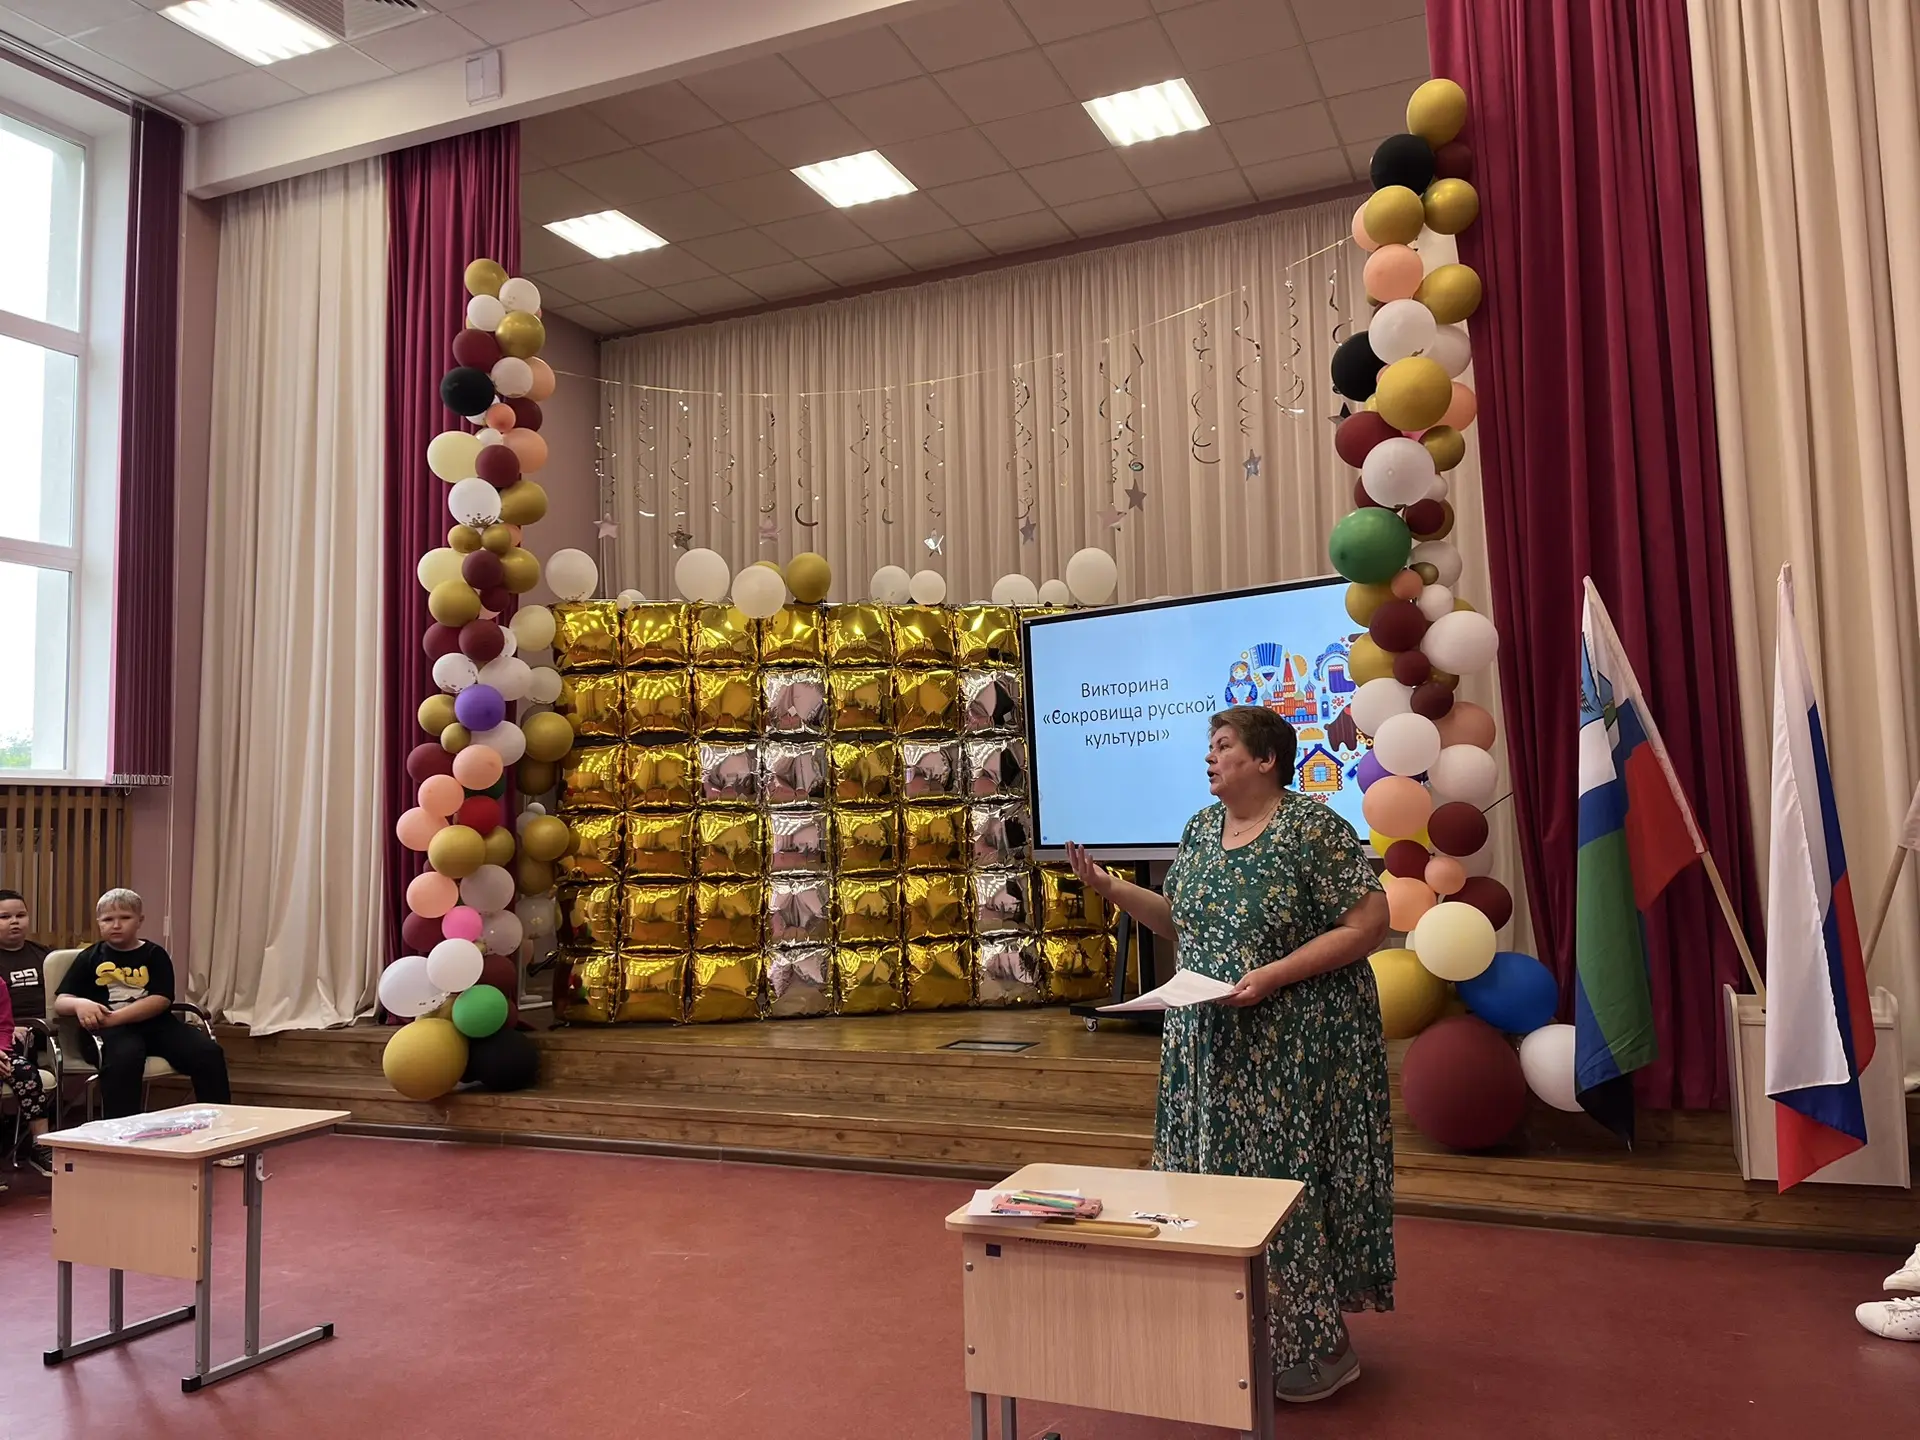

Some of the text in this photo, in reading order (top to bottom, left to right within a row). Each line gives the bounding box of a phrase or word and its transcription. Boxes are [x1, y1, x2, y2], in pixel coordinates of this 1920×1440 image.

[1081, 678, 1169, 698] Викторина
[1043, 694, 1216, 726] «Сокровища русской
[1085, 728, 1170, 750] культуры»
